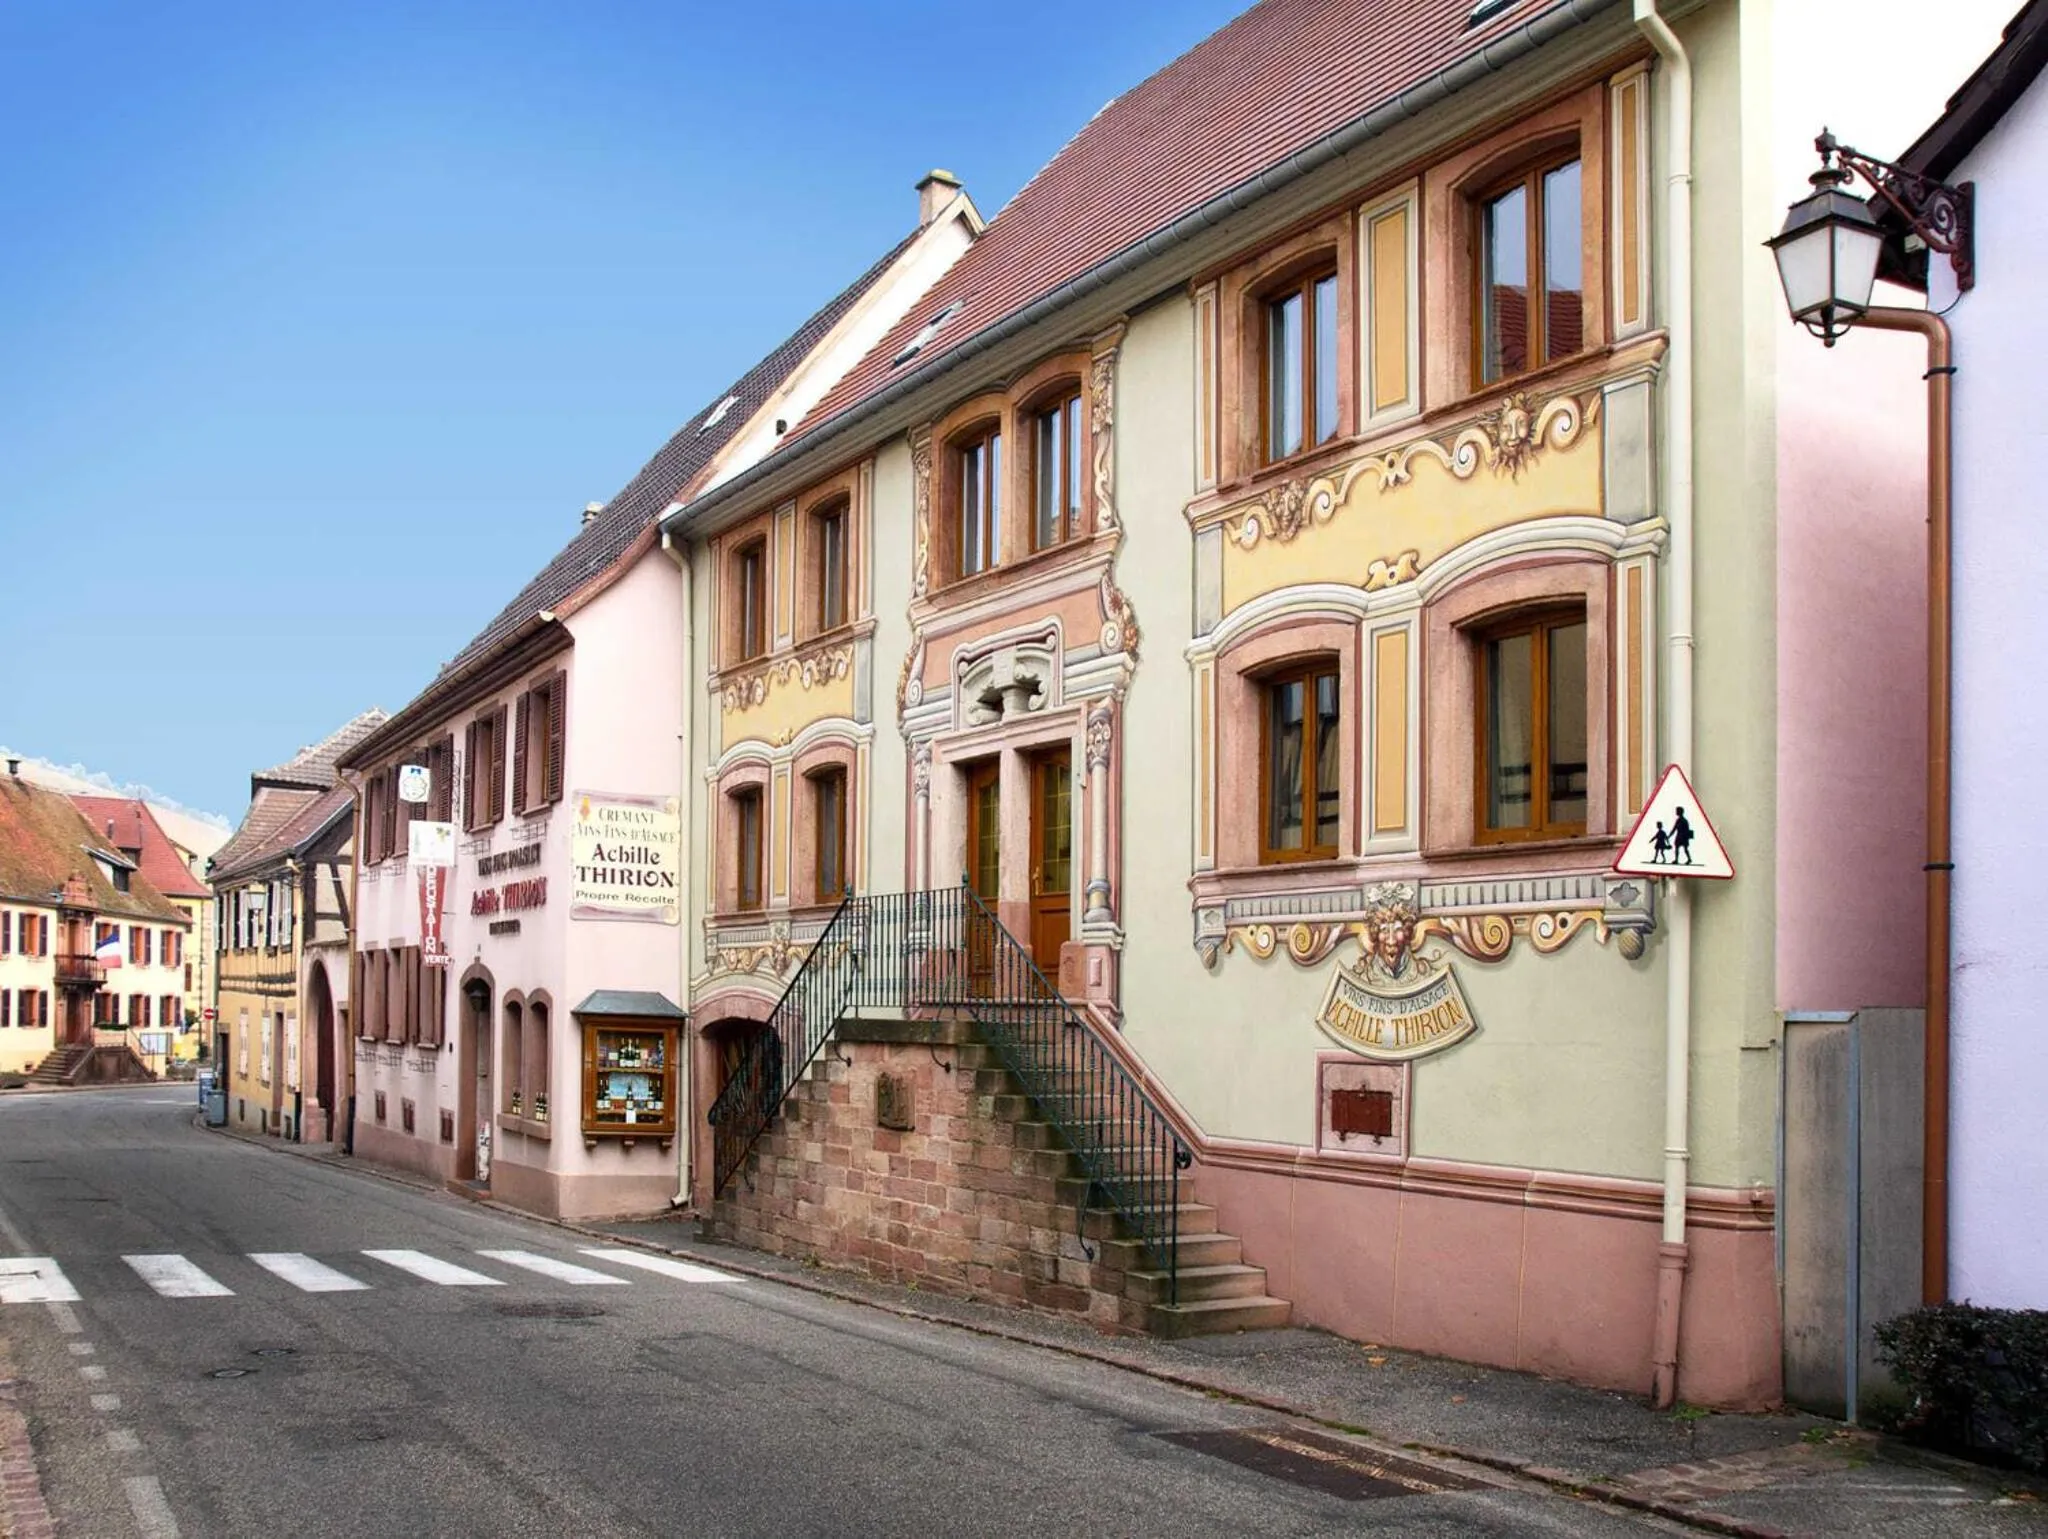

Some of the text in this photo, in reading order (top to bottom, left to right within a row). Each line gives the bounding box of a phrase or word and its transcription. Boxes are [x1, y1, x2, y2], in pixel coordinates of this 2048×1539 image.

[591, 843, 660, 865] Achille
[575, 866, 675, 888] THIRION
[575, 890, 619, 902] Propre
[1344, 983, 1449, 1014] VINS FINS D'ALSACE
[1327, 998, 1463, 1046] ACHILLE THIRION
